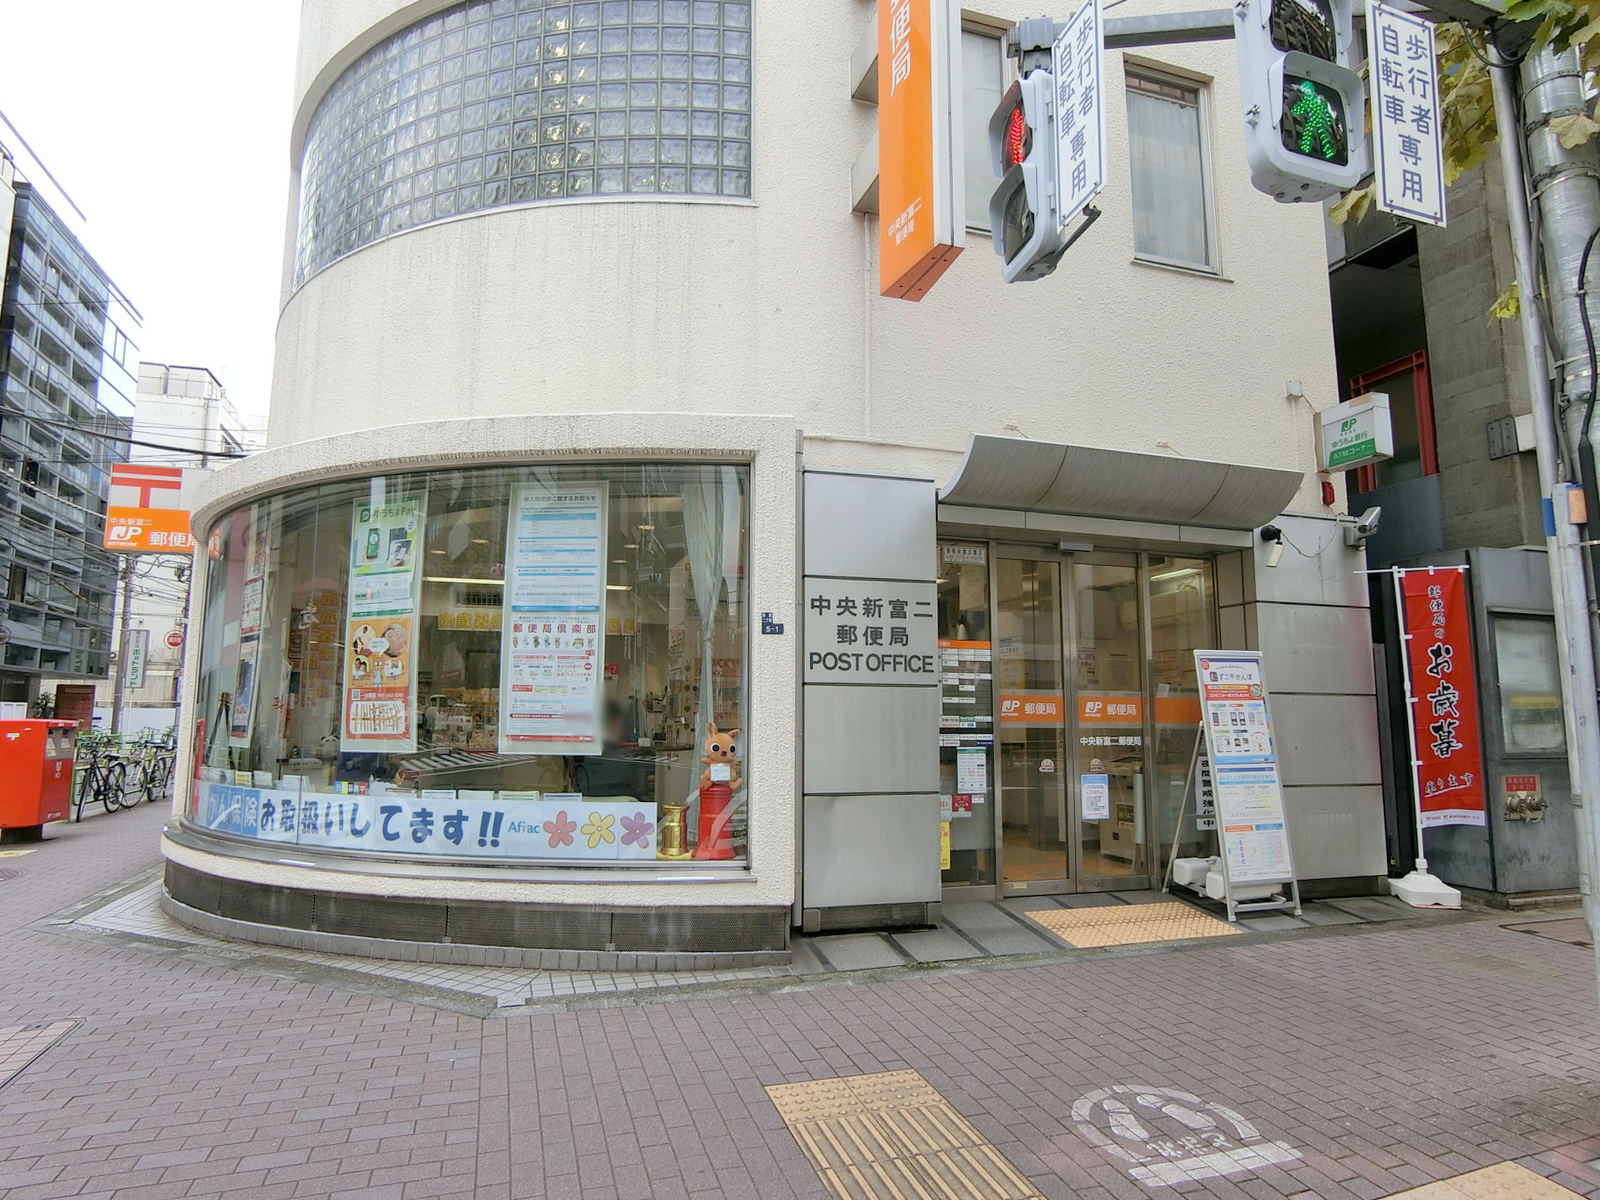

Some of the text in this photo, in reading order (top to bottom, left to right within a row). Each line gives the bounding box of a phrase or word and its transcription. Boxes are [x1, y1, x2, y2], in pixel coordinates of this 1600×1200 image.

[890, 0, 911, 97] 便局
[1077, 16, 1096, 117] 歩行者
[1380, 24, 1407, 124] 自転車
[1059, 42, 1077, 140] 自転車
[1405, 34, 1433, 135] 歩行者
[1069, 124, 1087, 200] 専用
[1398, 133, 1423, 203] 専用
[1331, 431, 1368, 448] ゆうちょ銀行
[110, 517, 153, 526] 中央新富二
[810, 595, 933, 619] 中央新富二
[1428, 585, 1446, 640] 郵便局の
[765, 625, 779, 633] 5-1
[836, 624, 909, 646] 郵便局
[809, 651, 863, 672] POST
[865, 653, 934, 673] OFFICE
[1024, 703, 1056, 715] 郵便局
[1106, 704, 1137, 716] 郵便局
[1426, 641, 1463, 759] お歳暮
[1080, 736, 1142, 746] 中央新富二郵便局
[507, 820, 541, 834] Aflac
